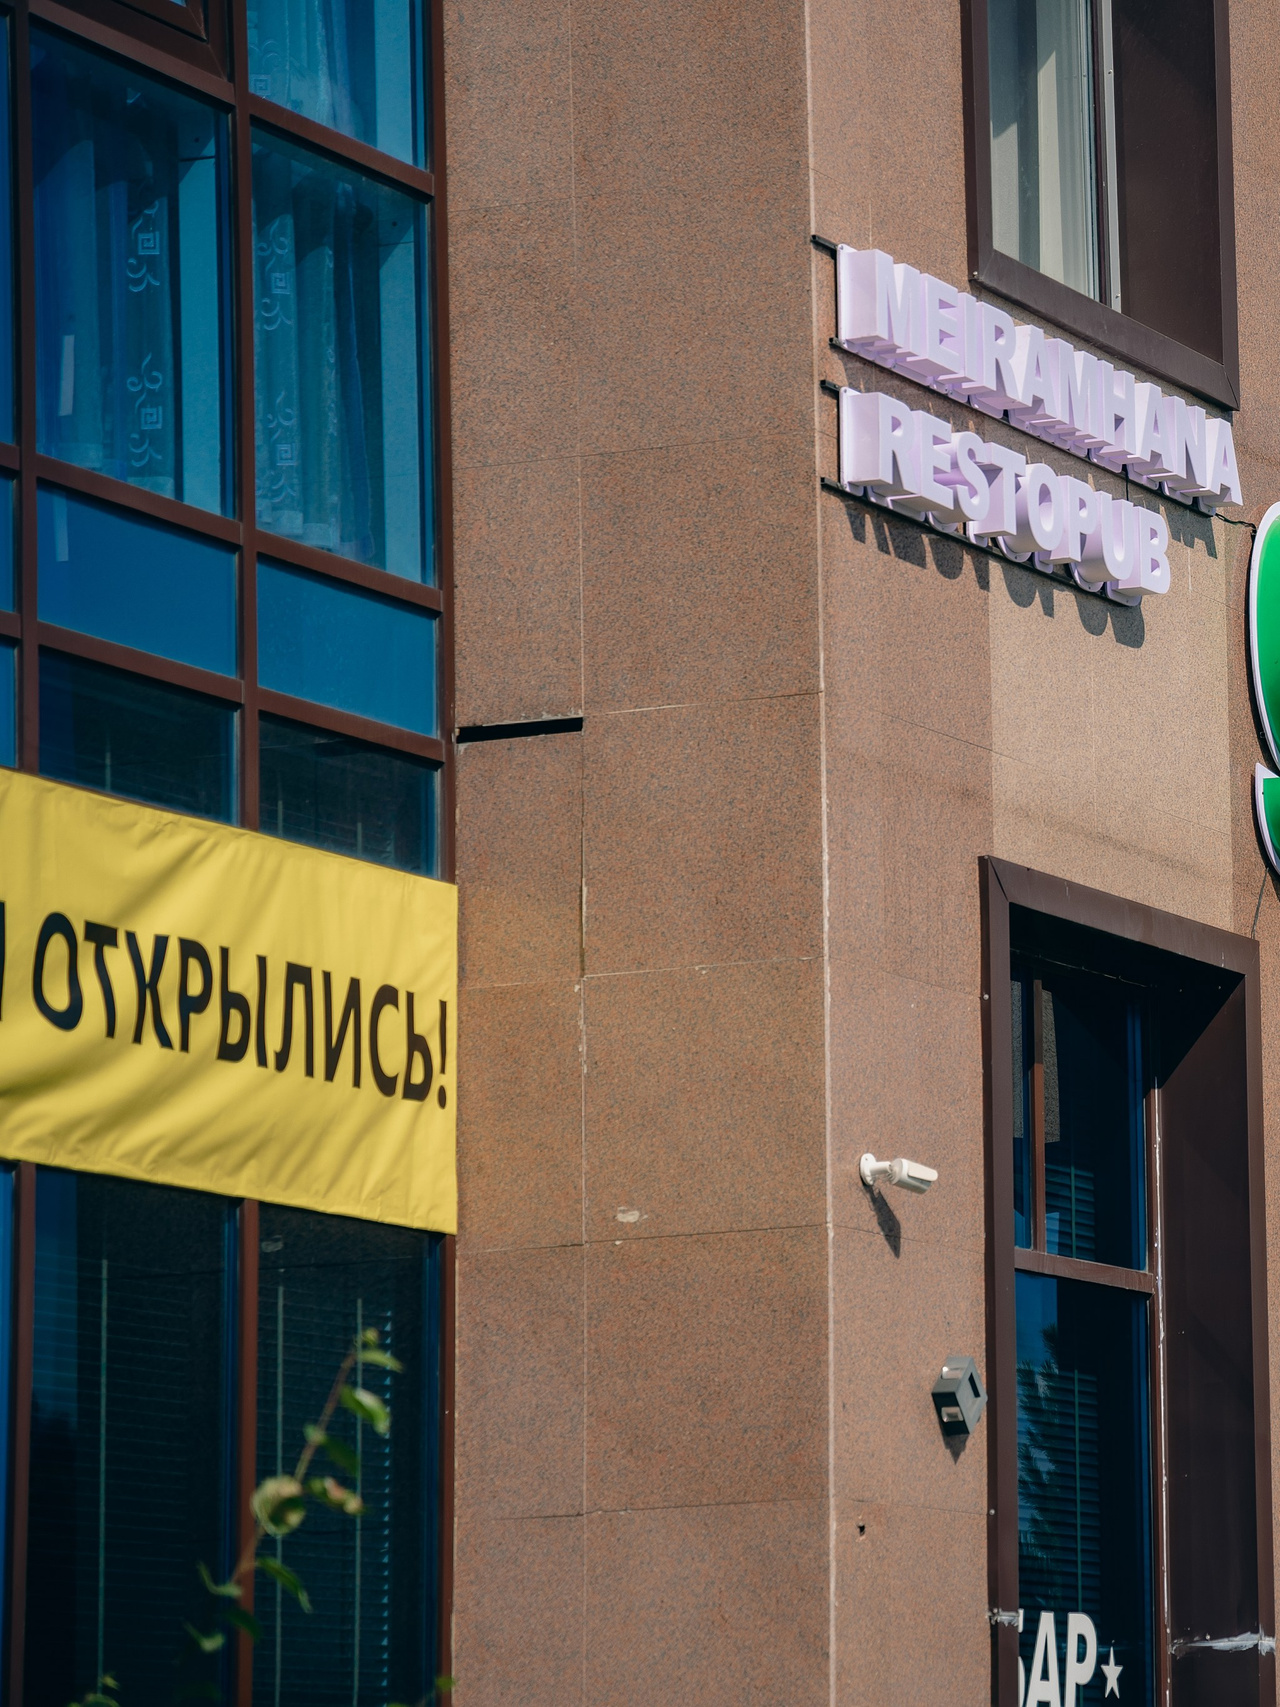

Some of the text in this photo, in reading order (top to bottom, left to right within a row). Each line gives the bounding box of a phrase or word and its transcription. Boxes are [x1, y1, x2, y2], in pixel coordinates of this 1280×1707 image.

[838, 244, 1243, 512] MEIRAMHANA
[840, 387, 1171, 606] RESTOPUB
[32, 912, 447, 1110] ОТКРЫЛИСЬ!
